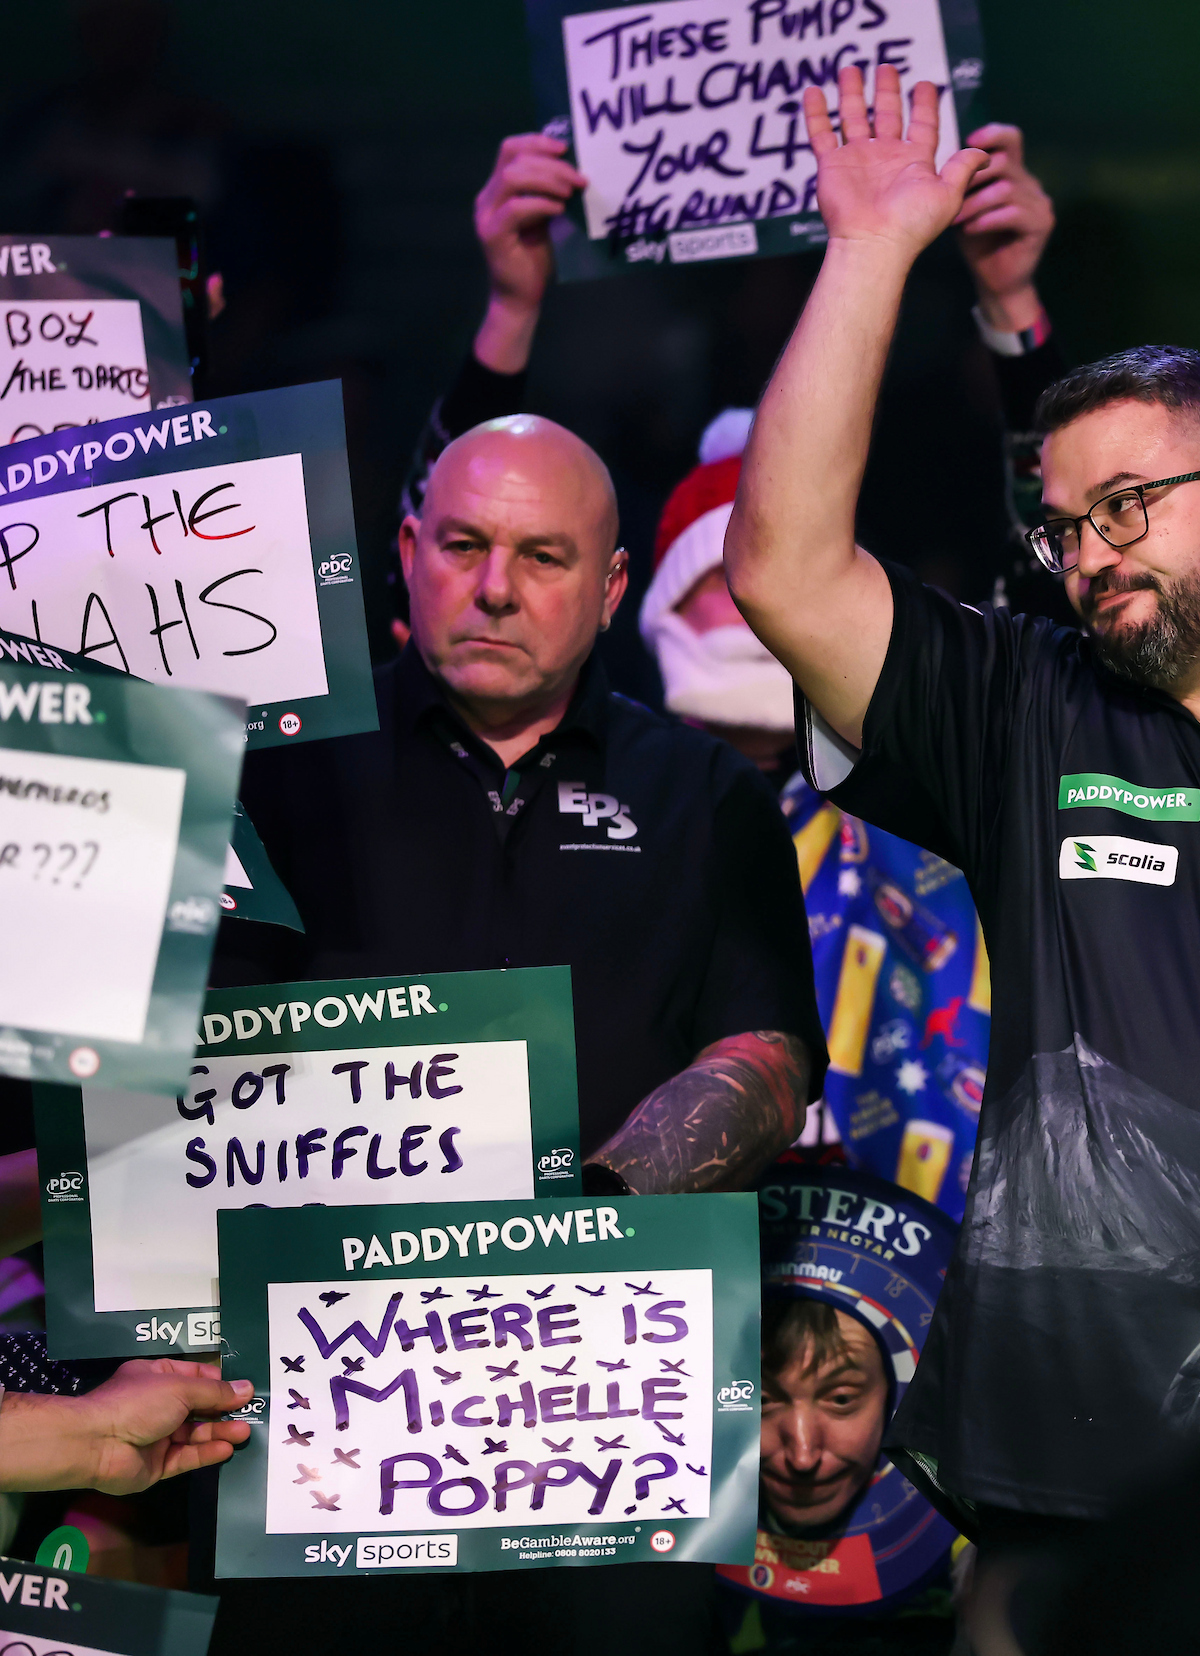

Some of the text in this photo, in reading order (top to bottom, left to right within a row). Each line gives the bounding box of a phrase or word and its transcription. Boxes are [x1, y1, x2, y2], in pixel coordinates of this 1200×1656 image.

[583, 0, 888, 82] THESE PUMPS
[581, 39, 913, 134] WILL CHANGE
[622, 130, 747, 198] YOUR
[77, 482, 257, 558] THE
[282, 719, 299, 729] 18+
[557, 781, 638, 840] EPS
[1106, 851, 1166, 873] scolia
[176, 1054, 464, 1125] GOT THE
[184, 1125, 464, 1189] SNIFFLES
[826, 1228, 896, 1262] NECTAR
[135, 1316, 184, 1345] sky
[297, 1292, 690, 1360] WHERE IS
[304, 1539, 452, 1568] sky sports
[501, 1533, 671, 1550] BeGambleAware.org 18+
[519, 1550, 554, 1561] Helpline:
[555, 1549, 577, 1558] 0808
